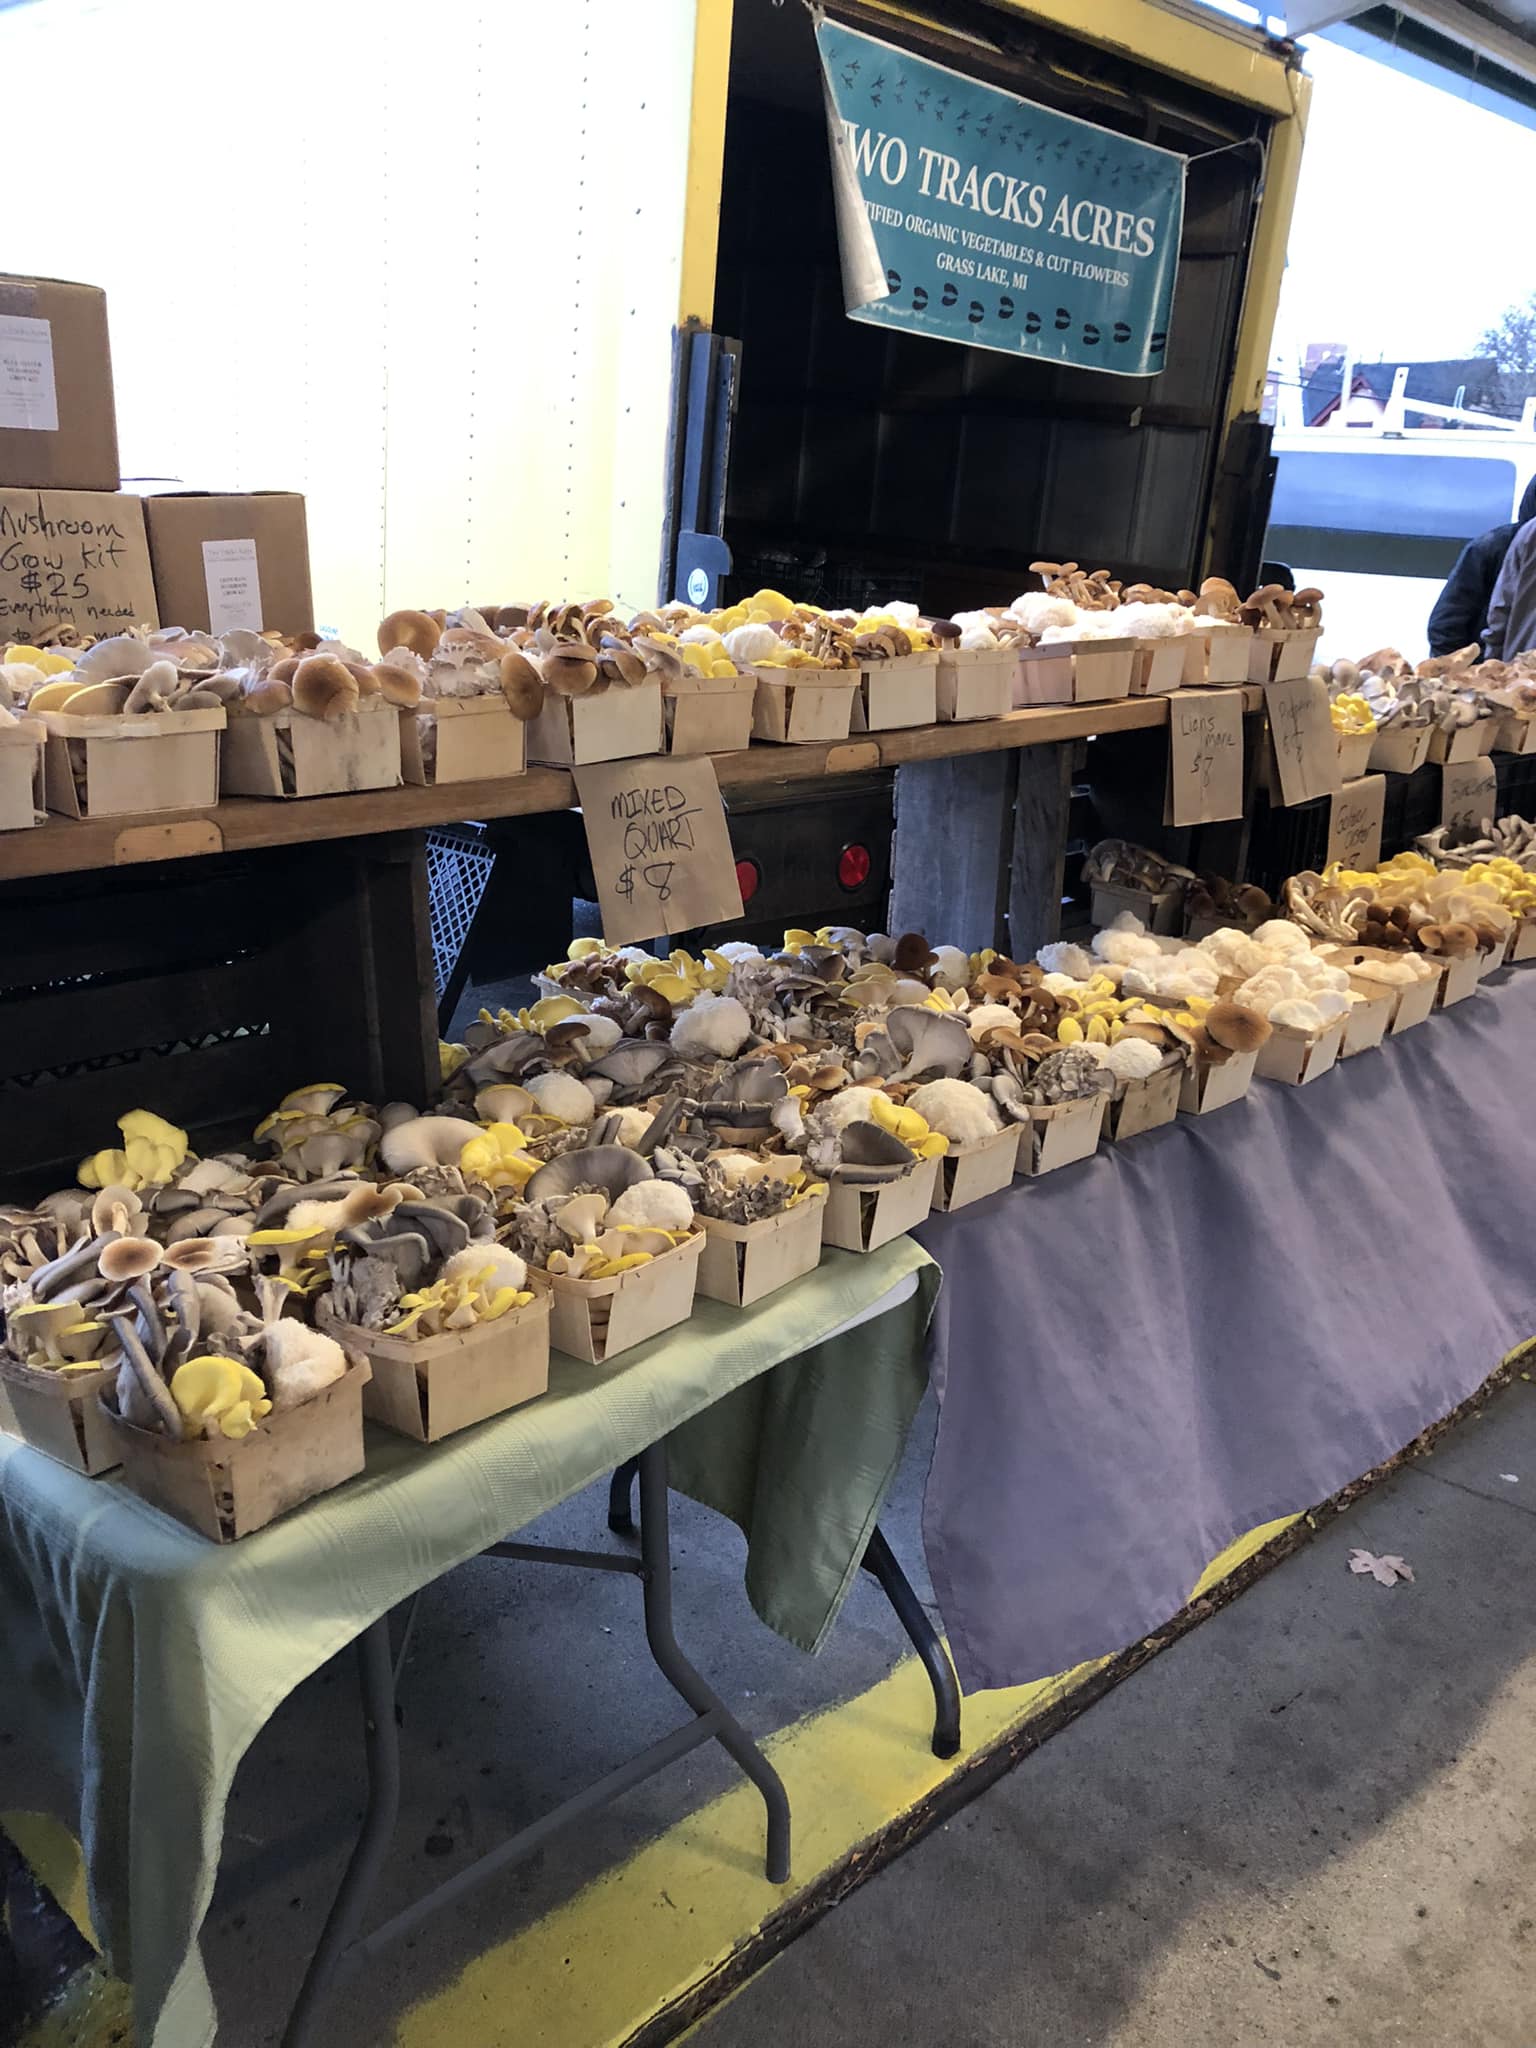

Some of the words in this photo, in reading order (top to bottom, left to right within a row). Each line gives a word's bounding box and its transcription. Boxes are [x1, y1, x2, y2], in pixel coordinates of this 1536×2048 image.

[918, 146, 1047, 229] TRACKS
[1048, 194, 1156, 257] ACRES
[863, 199, 903, 228] TIFIED
[904, 213, 960, 245] ORGANIC
[961, 229, 1035, 265] VEGETABLES
[1034, 250, 1045, 268] &
[1046, 253, 1072, 274] CUT
[1071, 260, 1129, 288] FLOWERS
[936, 251, 976, 278] GRASS
[976, 262, 1010, 289] LAKE,
[1012, 271, 1028, 290] MI
[20, 570, 90, 599] $25
[611, 785, 686, 820] MIXED
[623, 808, 703, 860] QUART
